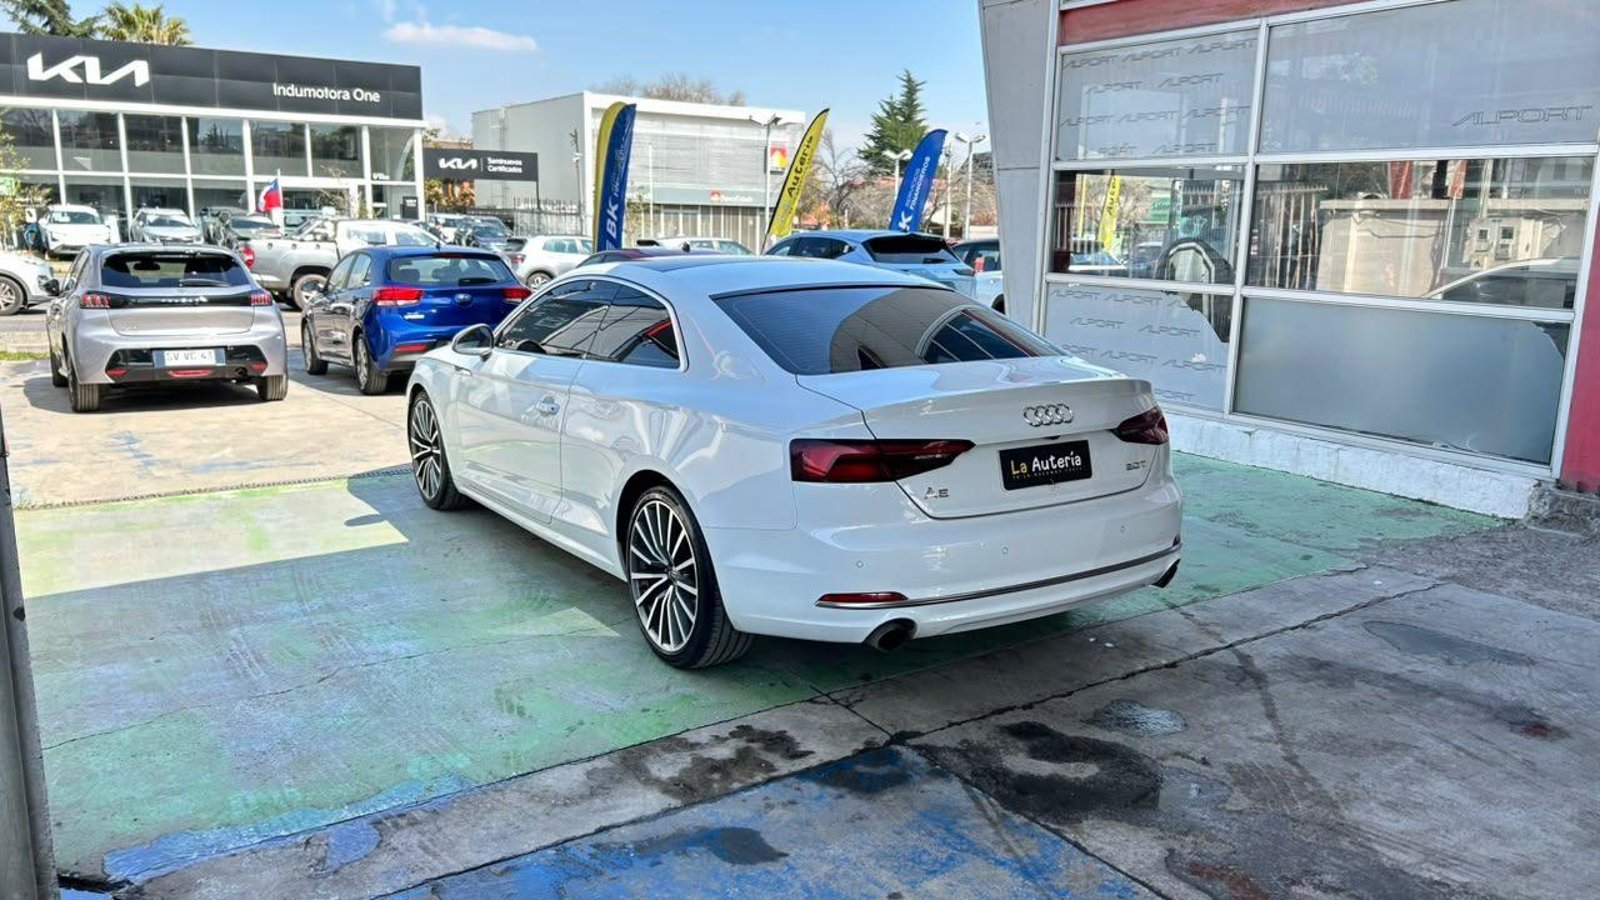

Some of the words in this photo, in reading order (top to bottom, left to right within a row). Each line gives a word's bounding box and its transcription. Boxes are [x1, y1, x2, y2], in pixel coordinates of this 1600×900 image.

[1122, 46, 1183, 63] ALPORT
[1158, 72, 1223, 89] ALPORT
[272, 82, 350, 101] Indumotora
[352, 87, 381, 103] One
[1117, 110, 1178, 124] ALPORT
[1452, 105, 1593, 127] ALPORT
[607, 197, 620, 239] BK
[1104, 292, 1163, 306] ALPORT
[1138, 323, 1201, 338] ALPORT
[1010, 460, 1028, 475] La
[1032, 451, 1083, 472] Autería
